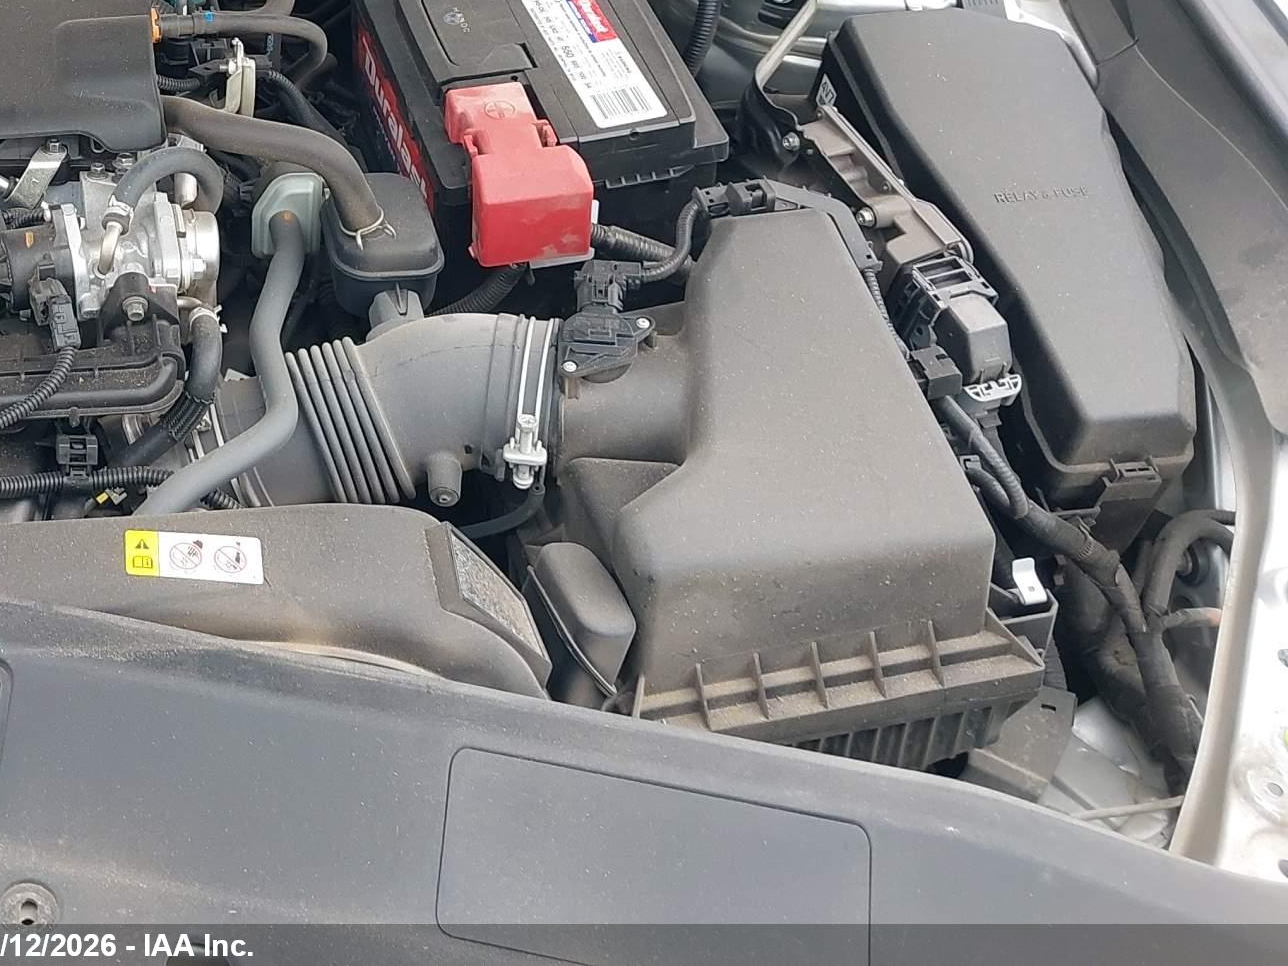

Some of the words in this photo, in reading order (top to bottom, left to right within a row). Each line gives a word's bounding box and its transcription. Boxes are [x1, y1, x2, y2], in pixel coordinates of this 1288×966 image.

[362, 36, 429, 200] Duralast
[993, 190, 1037, 203] RELAY
[1053, 186, 1089, 198] FUSE
